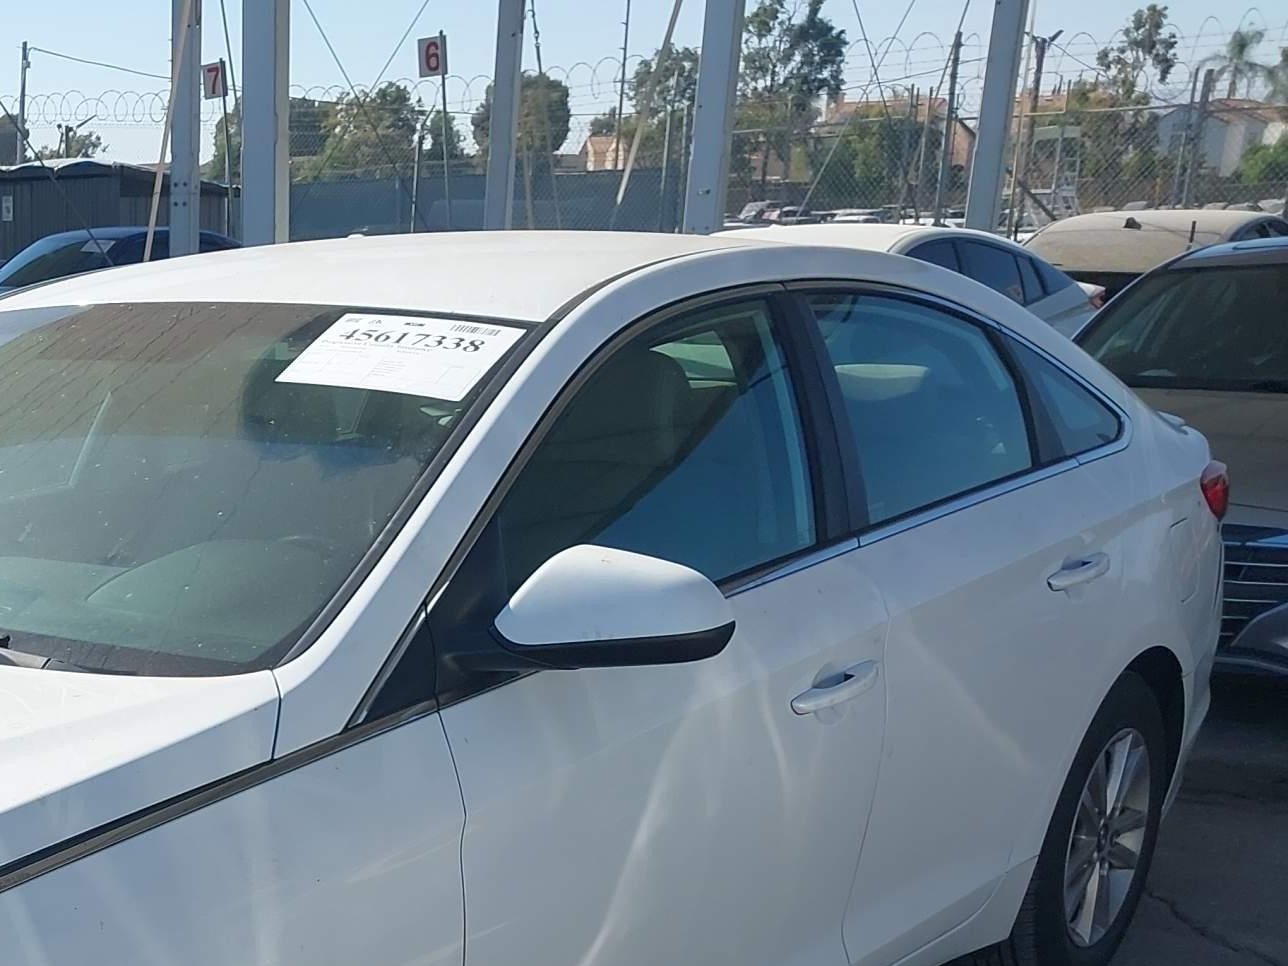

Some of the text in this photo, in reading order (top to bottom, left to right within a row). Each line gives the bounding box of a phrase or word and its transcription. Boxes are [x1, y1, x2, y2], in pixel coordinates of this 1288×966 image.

[425, 41, 440, 72] 6
[207, 66, 220, 94] 7
[339, 328, 486, 354] 45617338
